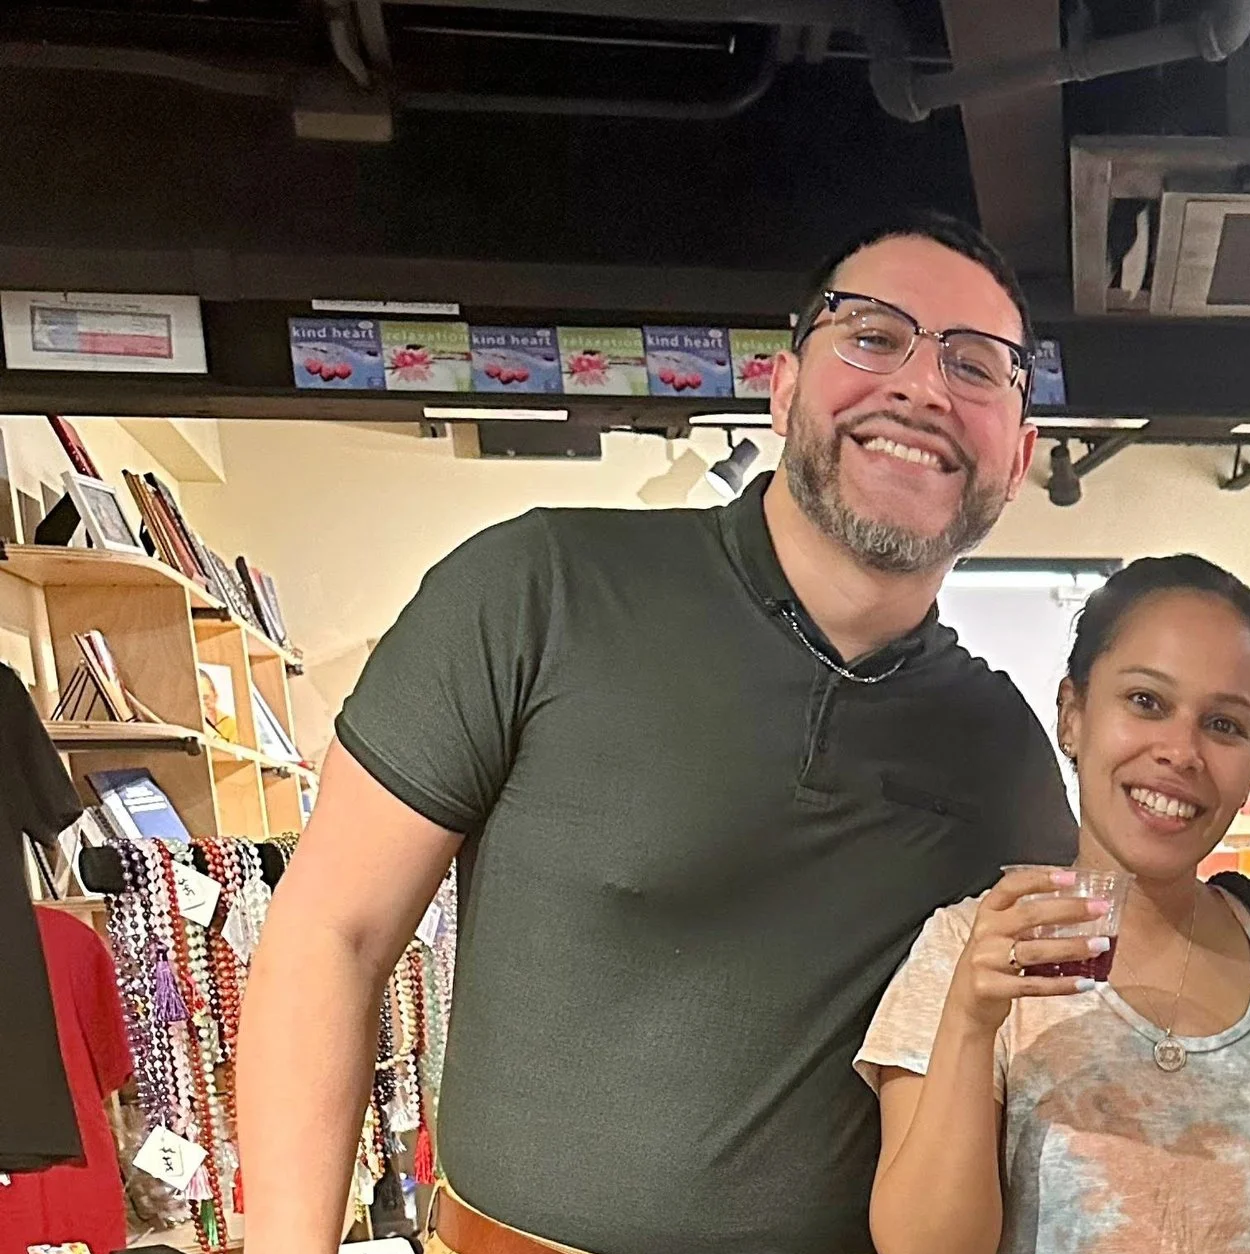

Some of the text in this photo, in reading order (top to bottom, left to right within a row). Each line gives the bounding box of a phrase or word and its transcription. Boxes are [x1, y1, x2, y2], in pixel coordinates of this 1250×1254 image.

[291, 326, 375, 340] kind heart
[383, 330, 470, 343] relaxation
[472, 333, 552, 346] kind heart
[647, 335, 724, 350] kind heart
